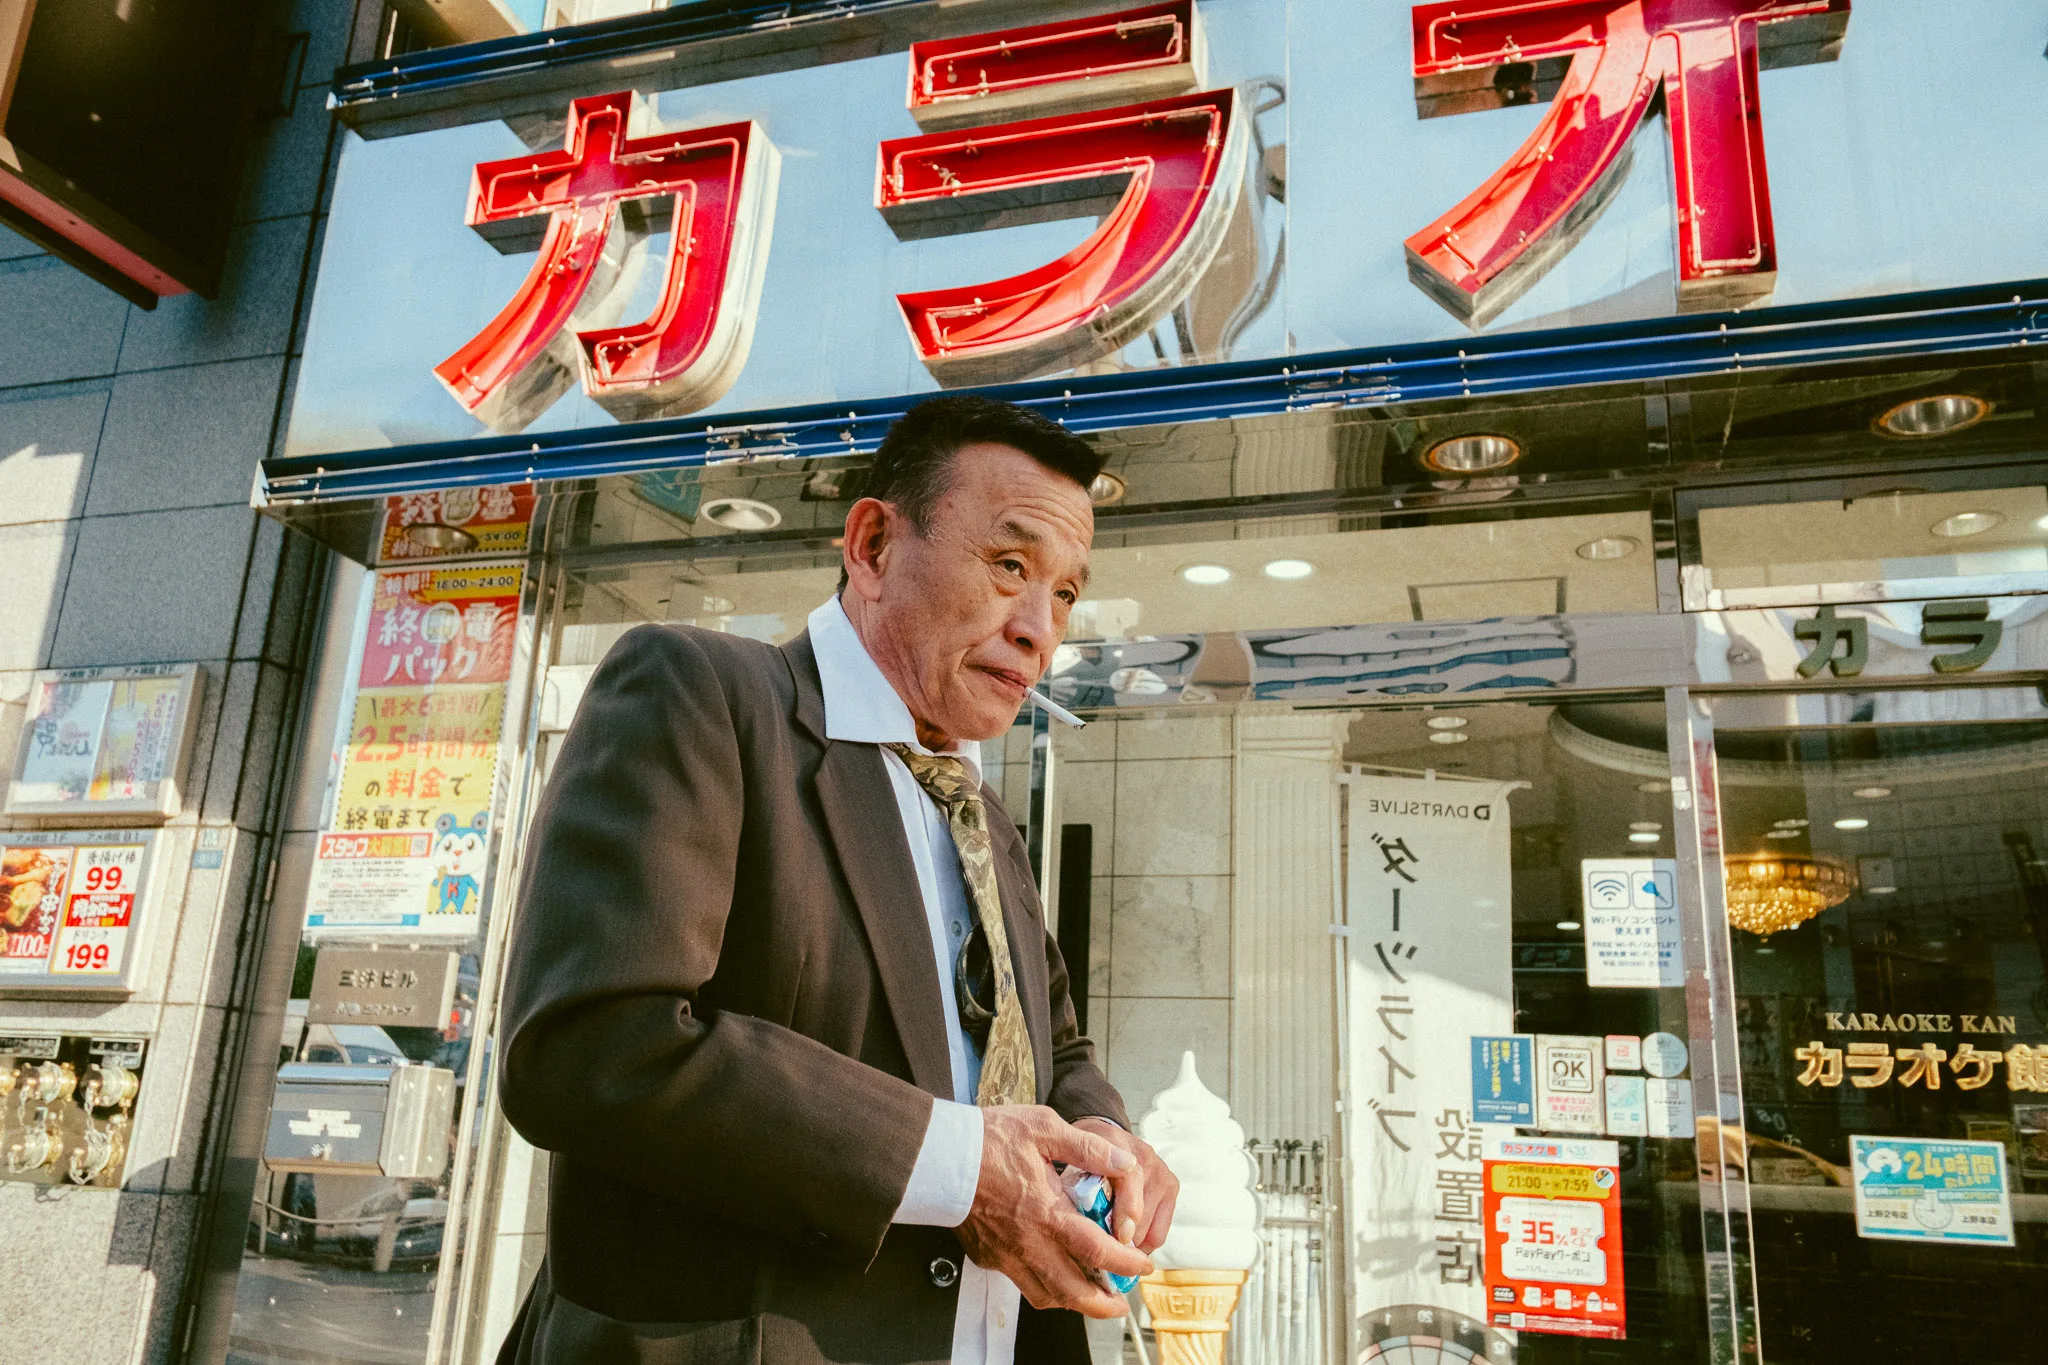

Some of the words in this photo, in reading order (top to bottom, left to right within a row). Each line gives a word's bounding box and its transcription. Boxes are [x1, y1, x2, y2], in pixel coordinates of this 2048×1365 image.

[383, 646, 478, 682] パック
[356, 725, 495, 763] 2.5時間分
[365, 765, 472, 799] の料金で
[345, 804, 437, 830] 終電まで
[1825, 1012, 1953, 1032] KARAOKE
[1960, 1015, 2016, 1034] KAN
[1553, 1060, 1585, 1078] OK
